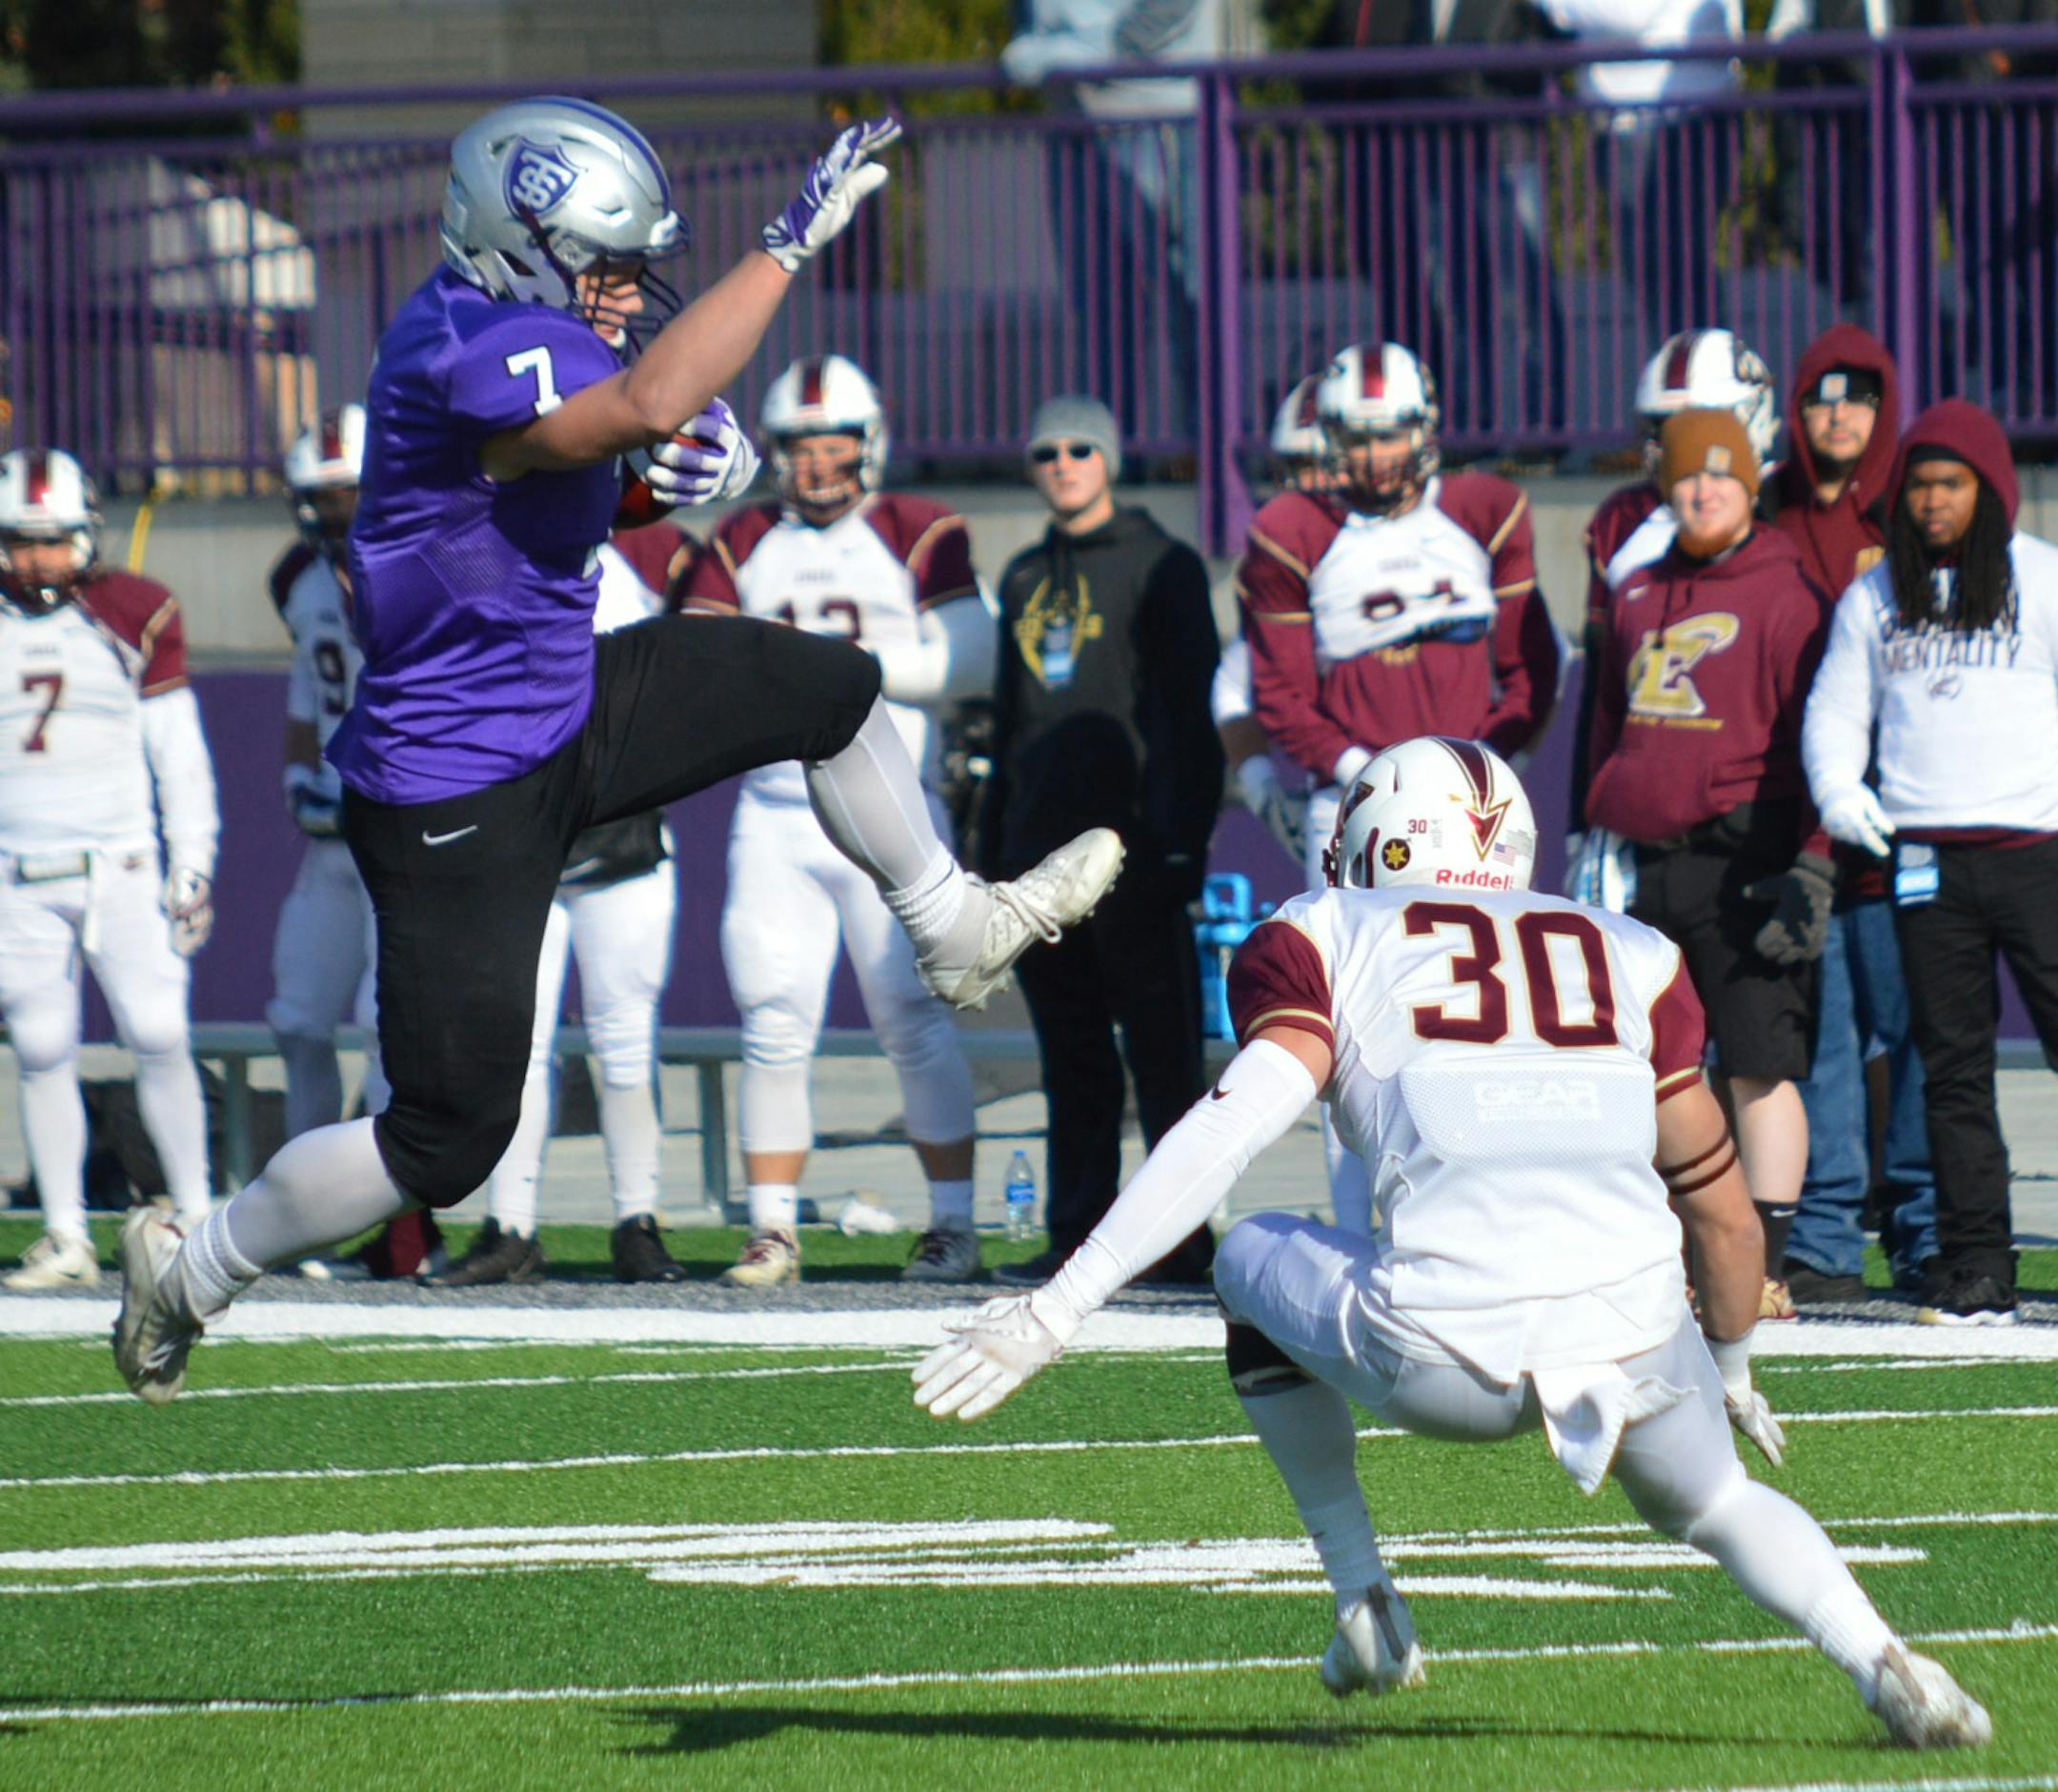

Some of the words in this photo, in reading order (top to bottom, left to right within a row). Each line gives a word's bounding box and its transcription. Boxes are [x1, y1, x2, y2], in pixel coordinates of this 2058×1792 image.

[506, 345, 564, 416] 7
[23, 674, 63, 752] 7
[313, 639, 346, 715] 9
[1408, 818, 1427, 834] 30
[1402, 901, 1621, 1047] 30
